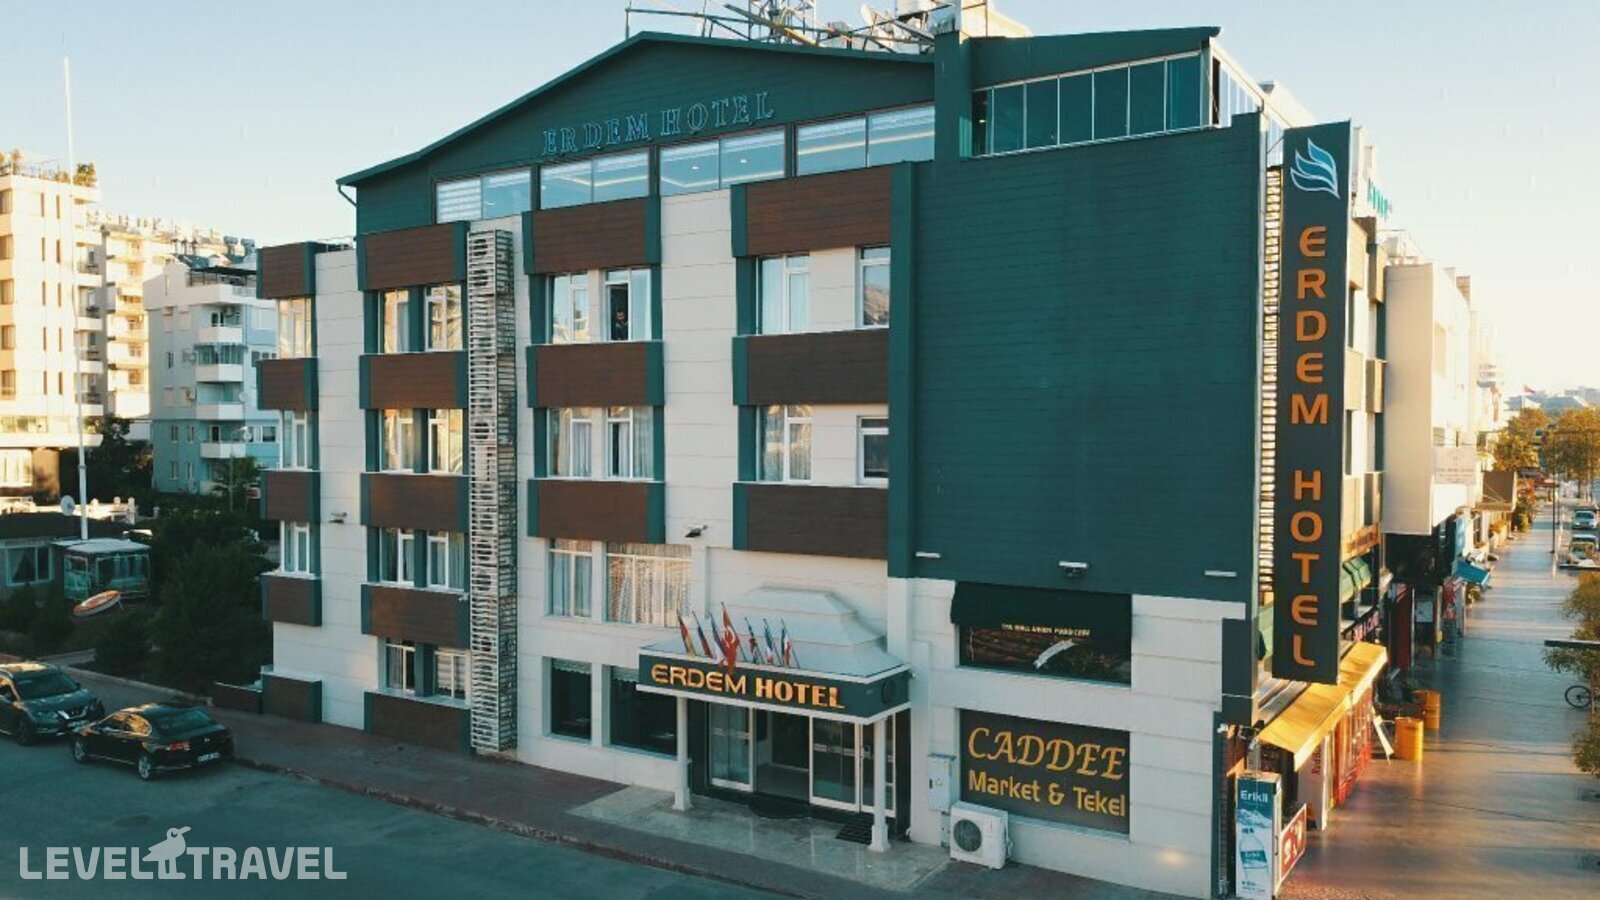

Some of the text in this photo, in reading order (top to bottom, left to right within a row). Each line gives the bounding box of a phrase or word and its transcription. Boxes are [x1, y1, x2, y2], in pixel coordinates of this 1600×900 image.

[543, 92, 774, 154] ERDEM HOTEL
[1290, 226, 1328, 667] ERDEM HOTEL
[651, 664, 845, 708] ERDEM HOTEL
[968, 727, 1126, 780] CADDEE
[968, 770, 1125, 816] Market & Tekel
